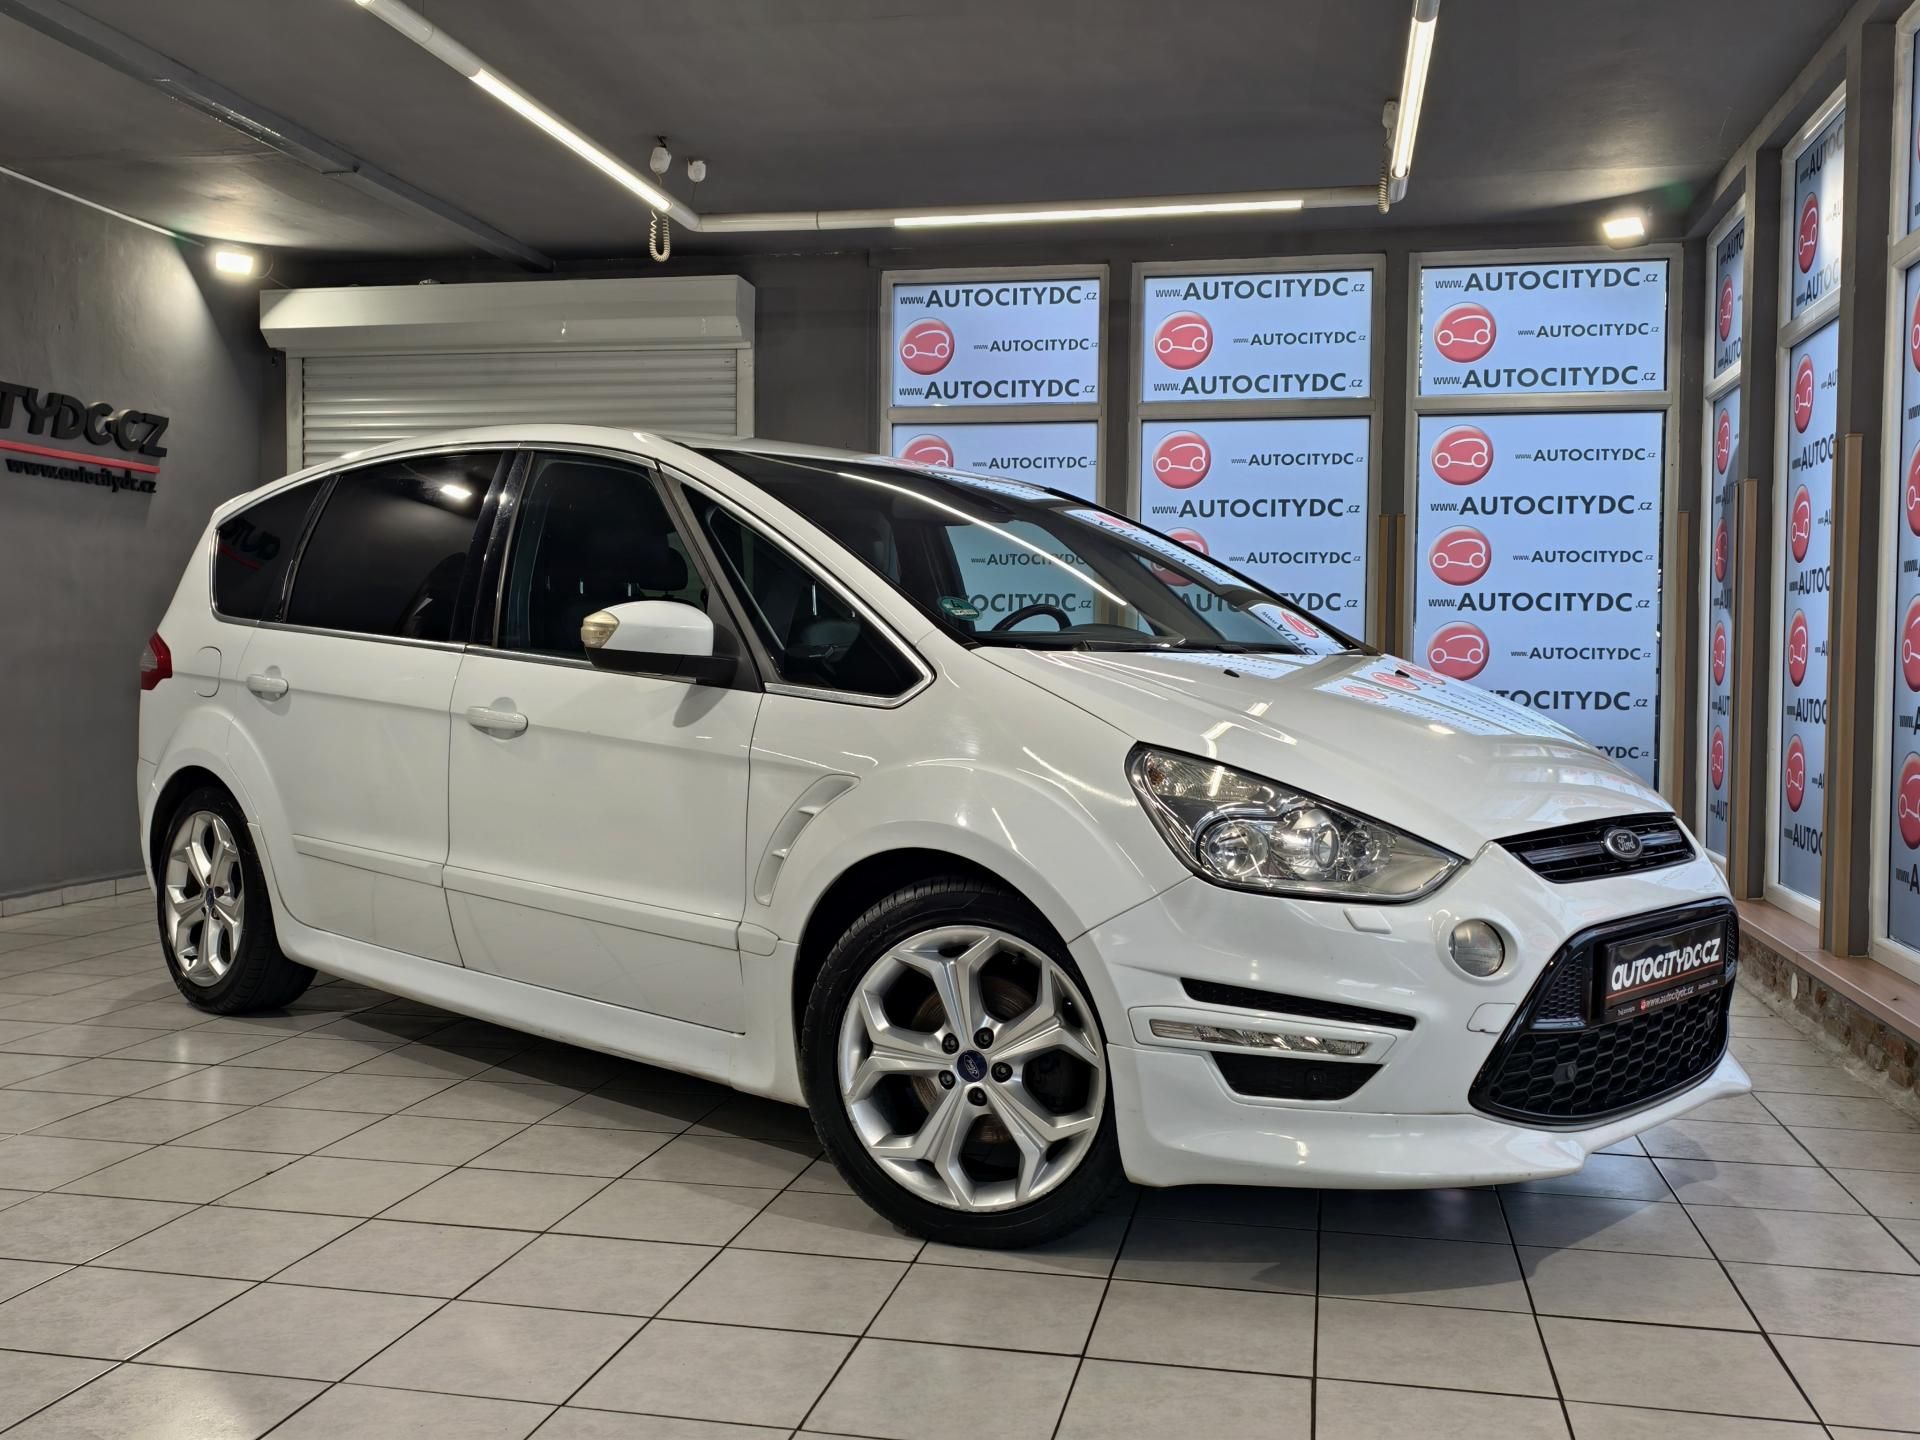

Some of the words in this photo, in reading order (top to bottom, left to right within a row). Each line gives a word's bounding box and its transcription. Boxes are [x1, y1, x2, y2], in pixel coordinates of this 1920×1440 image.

[1155, 277, 1365, 301] www.AUTOCITYDC.cz
[1435, 267, 1658, 292] www.AUTOCITYDC.cz
[900, 286, 1097, 307] www.AUTOCITYDC.cz
[1153, 373, 1362, 395] www.AUTOCITYDC.cz
[1433, 365, 1656, 389] www.AUTOCITYDC.cz
[899, 378, 1095, 399] www.AUTOCITYDC.cz
[1152, 498, 1360, 518] www.AUTOCITYDC.cz
[1430, 495, 1652, 515] www.AUTOCITYDC.cz
[1428, 592, 1650, 612] www.AUTOCITYDC.cz
